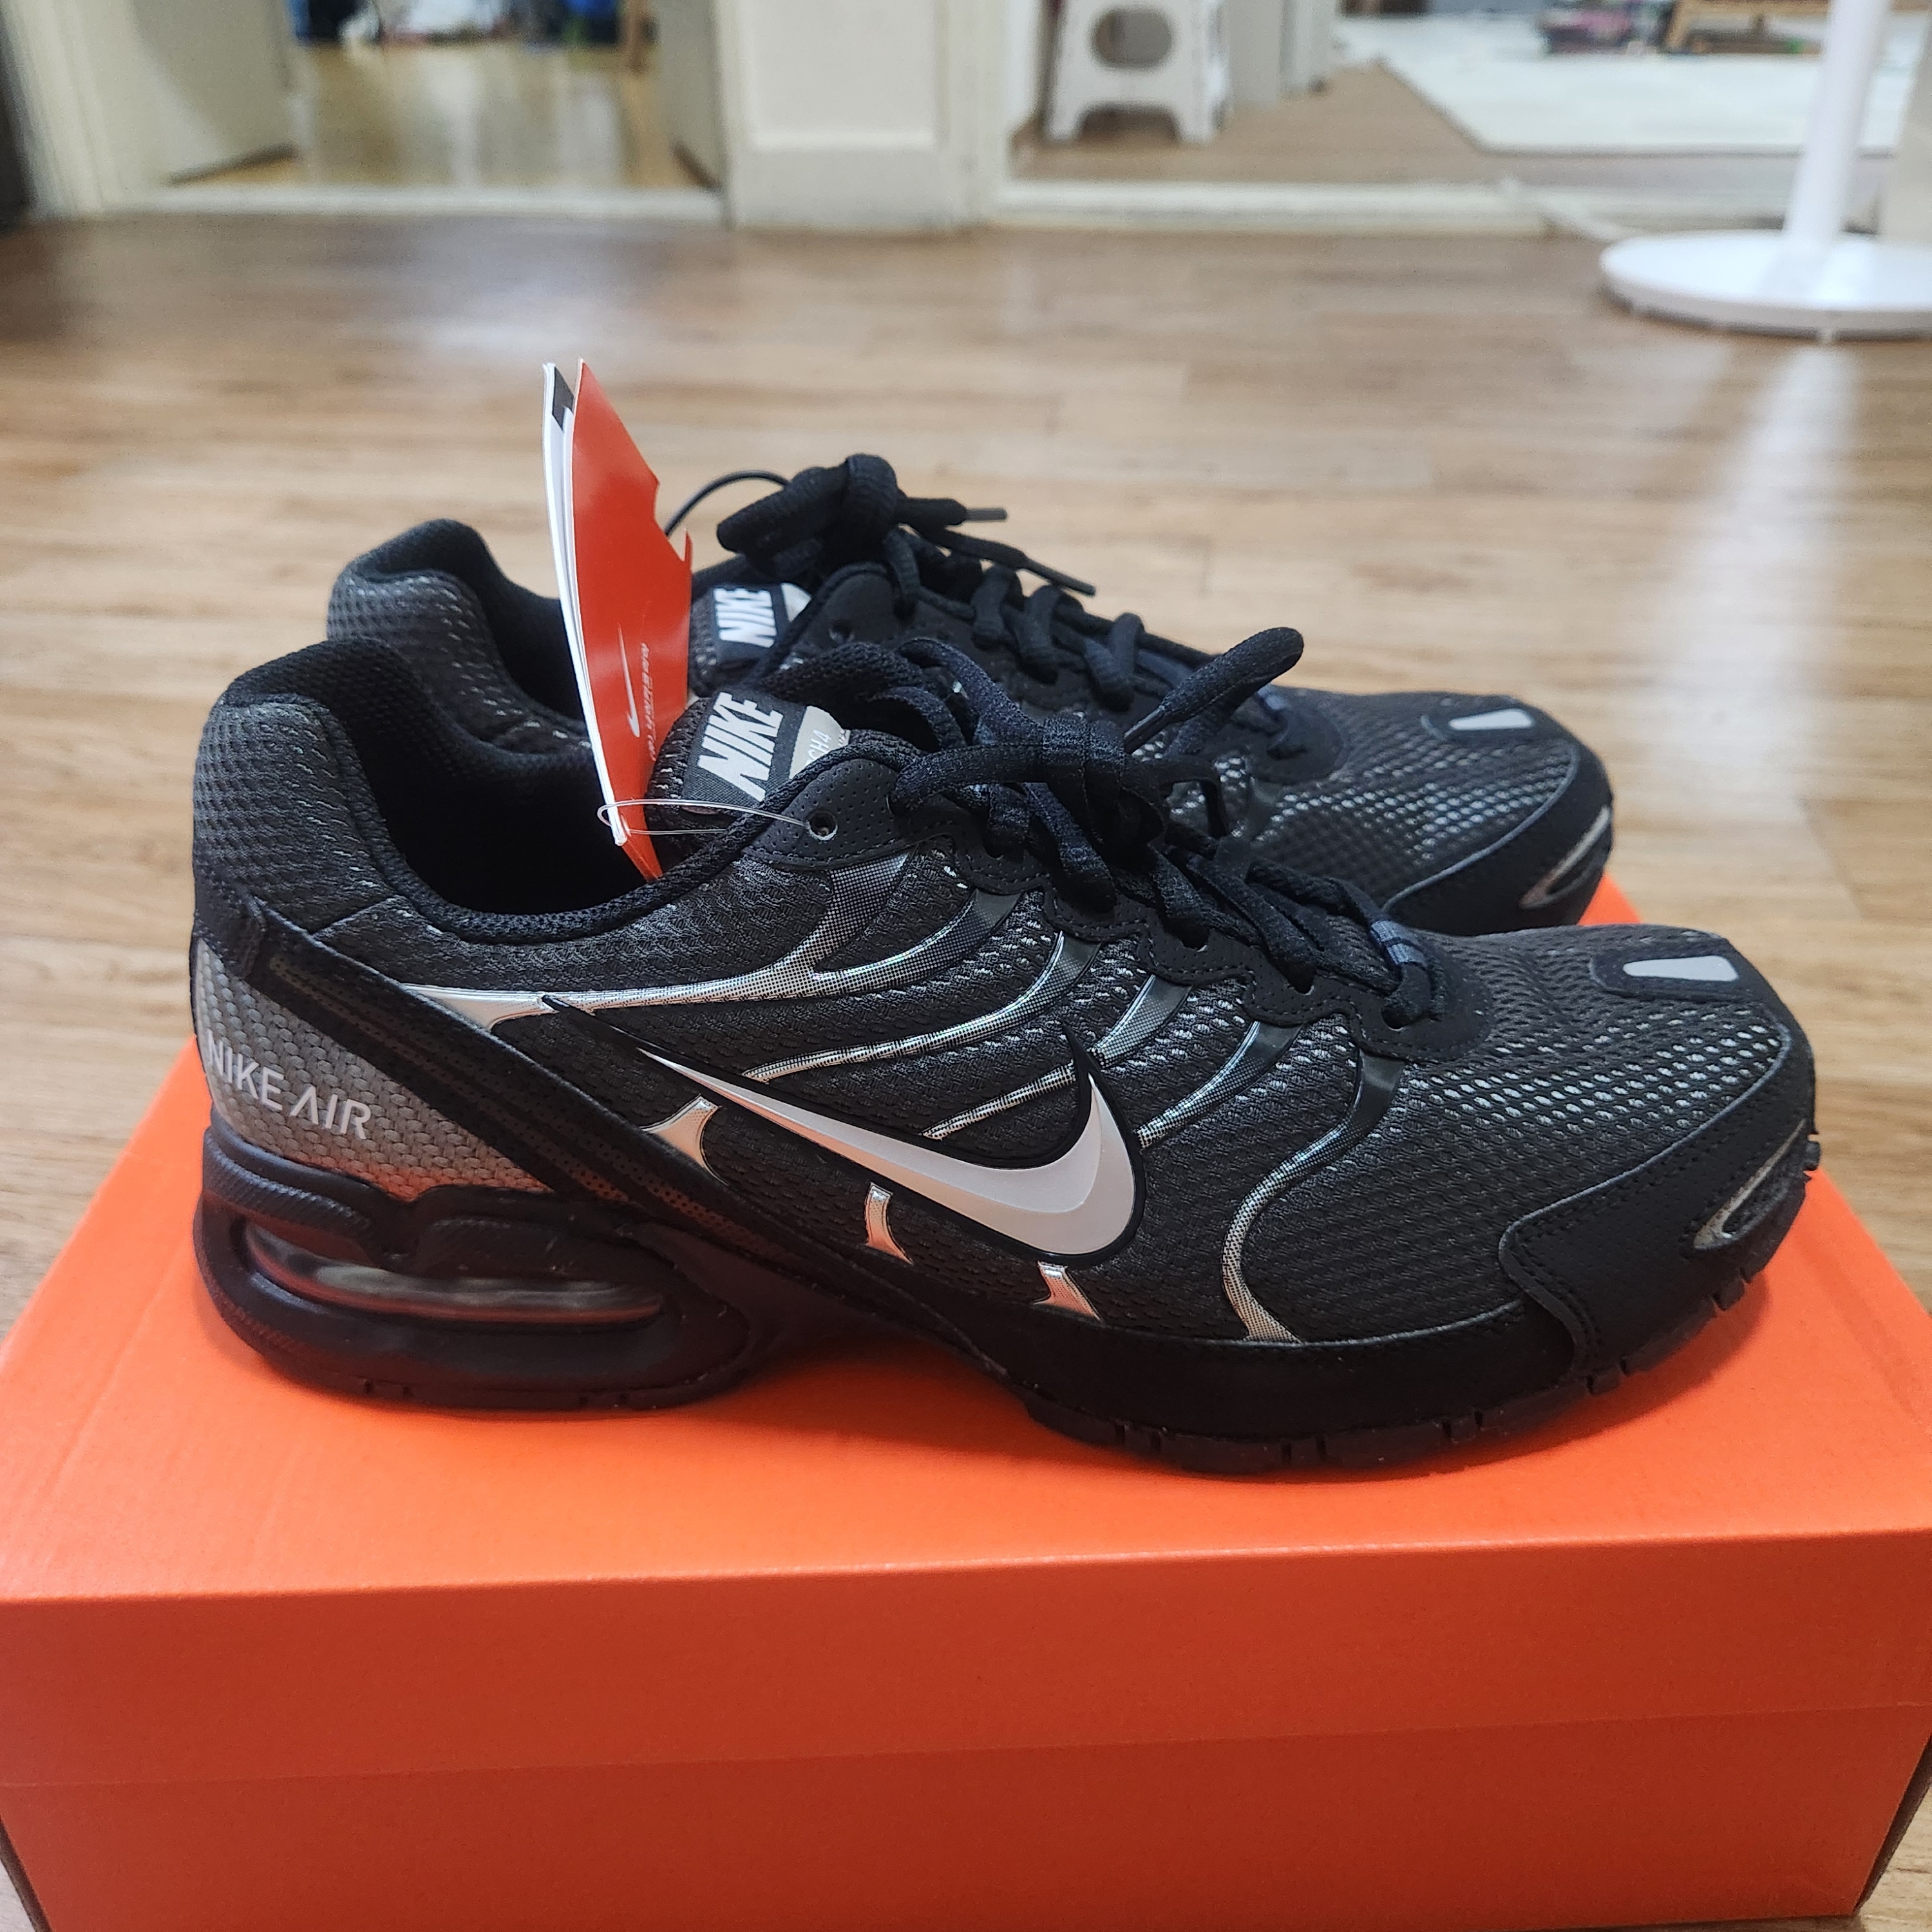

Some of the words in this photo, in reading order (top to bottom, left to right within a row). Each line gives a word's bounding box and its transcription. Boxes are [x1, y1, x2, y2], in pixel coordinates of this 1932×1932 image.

[713, 587, 778, 649] NIKE
[697, 691, 784, 802] NIKE
[207, 1028, 285, 1112] NIKE
[290, 1085, 372, 1140] AIR
